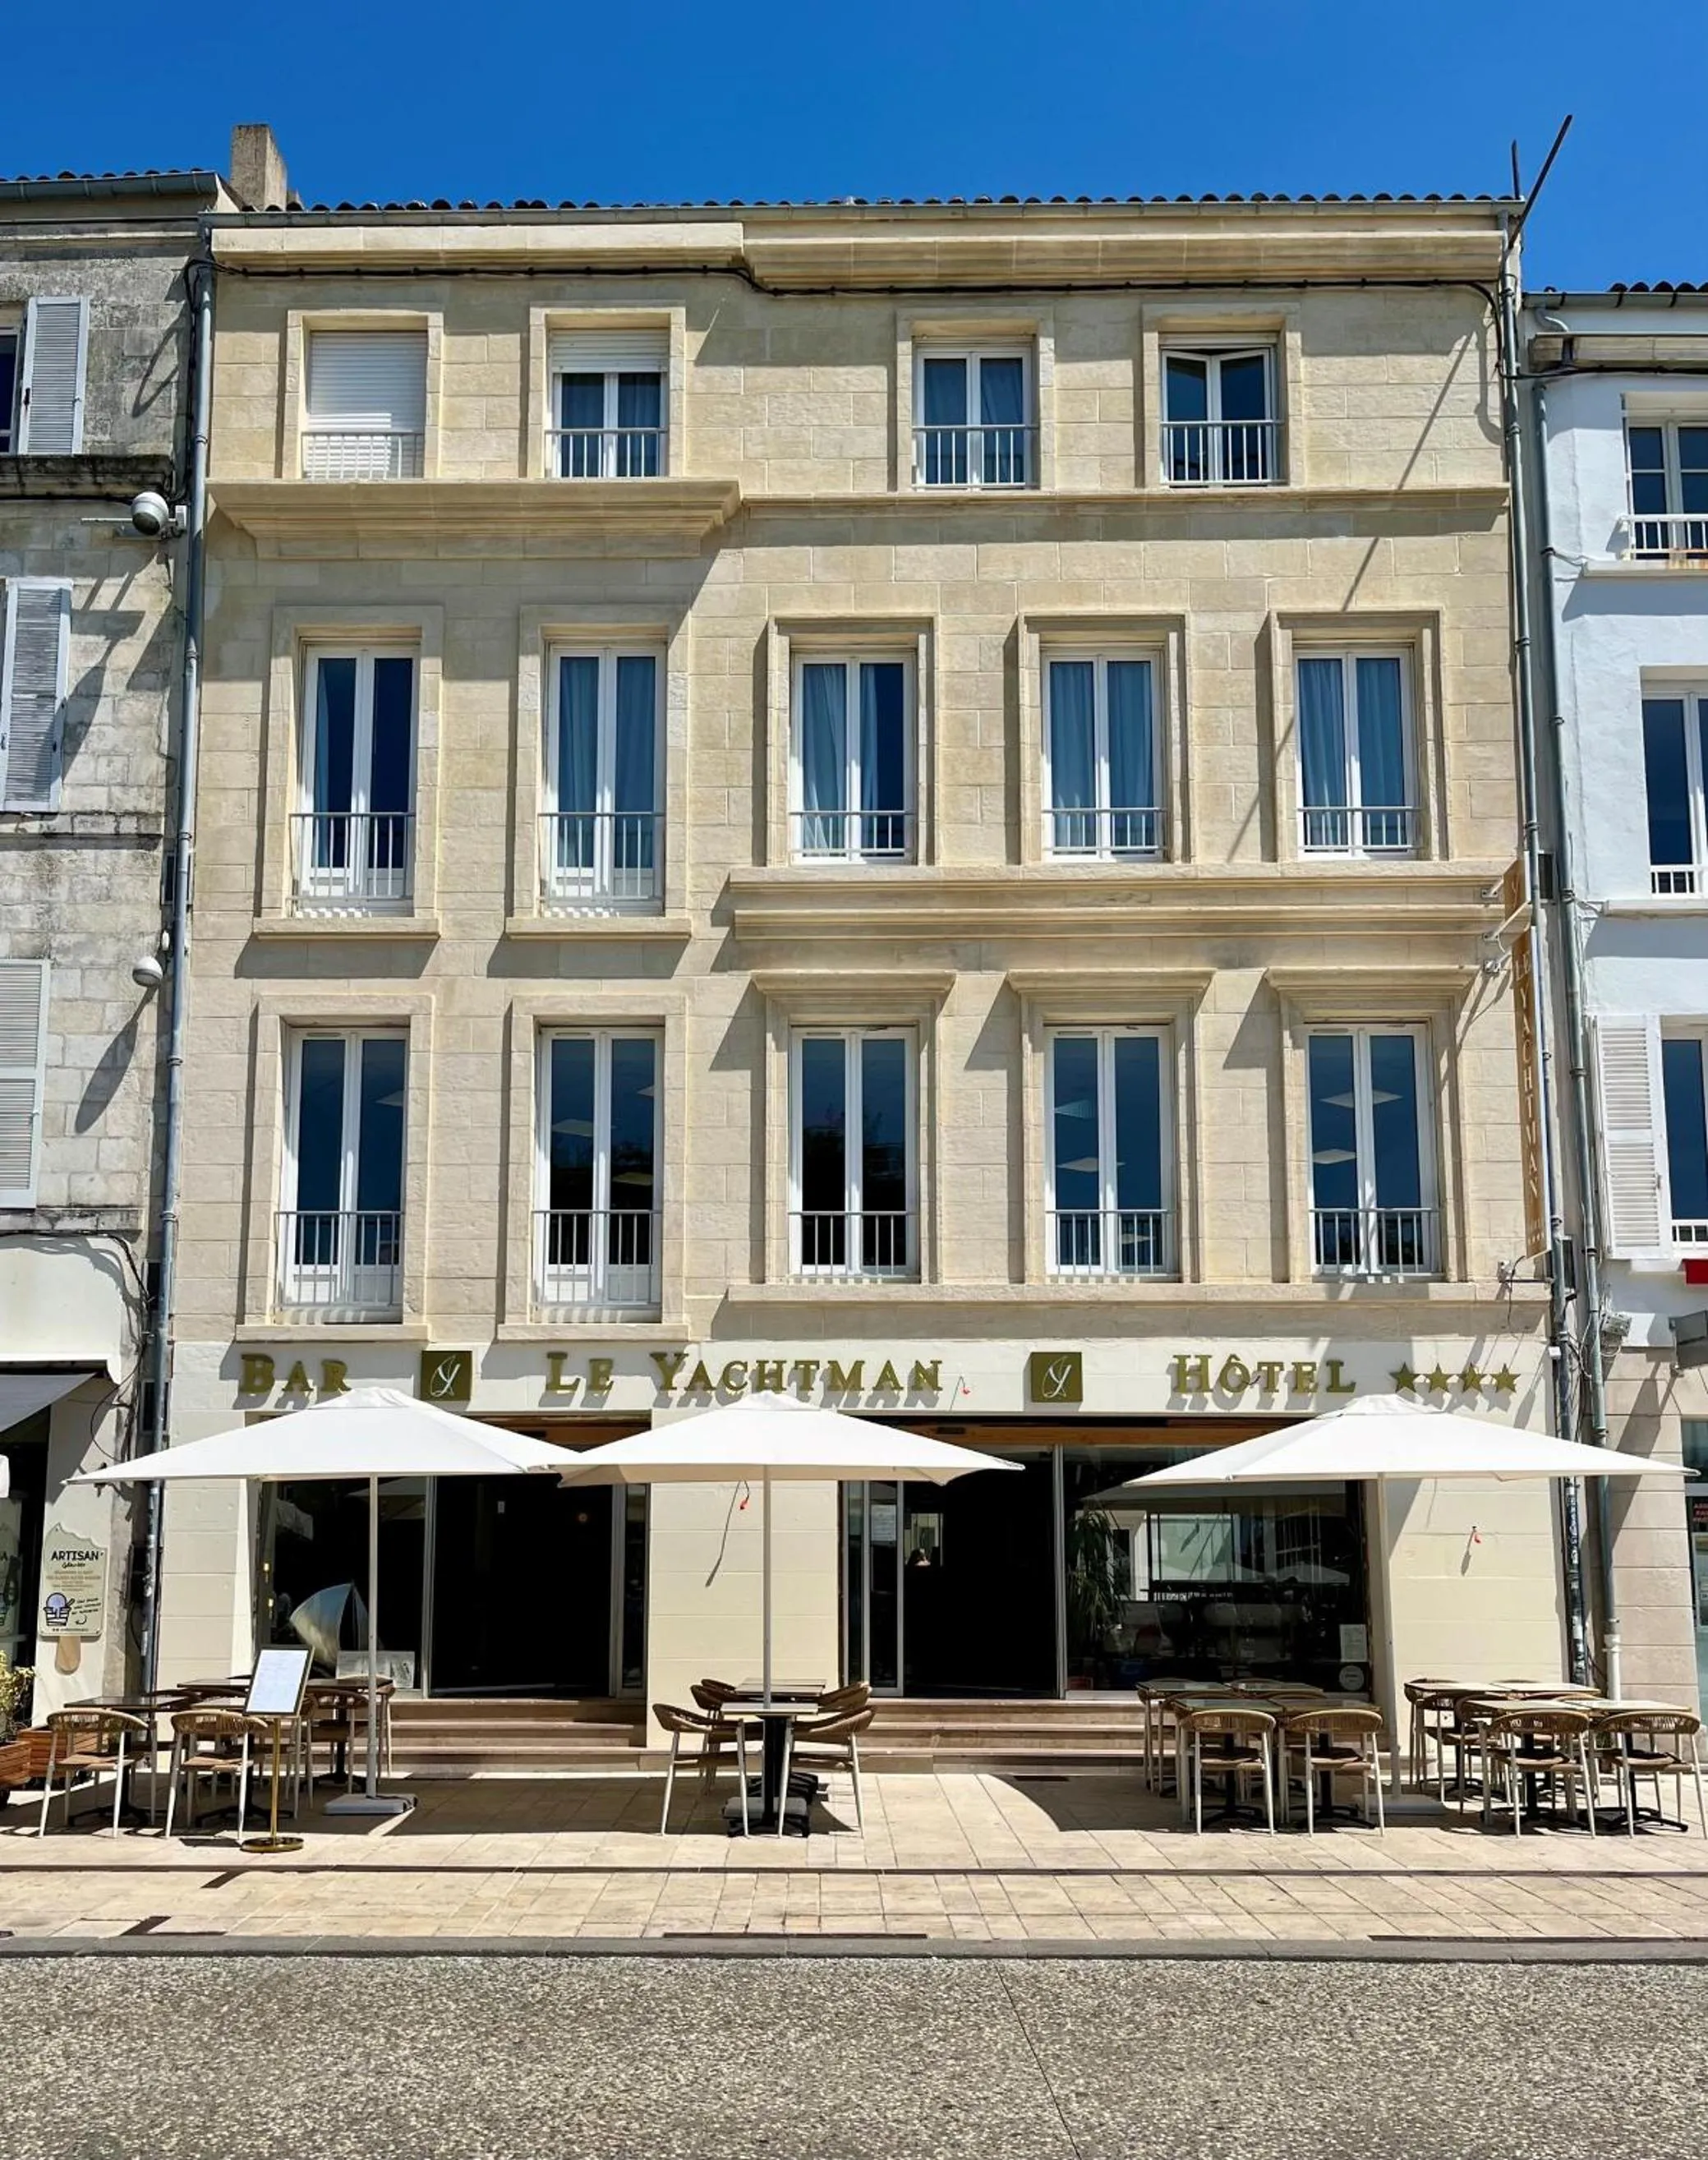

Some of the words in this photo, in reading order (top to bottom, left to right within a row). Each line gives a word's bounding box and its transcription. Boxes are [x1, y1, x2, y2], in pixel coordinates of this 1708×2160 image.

[1520, 980, 1538, 1202] YACHTMAN
[240, 1353, 352, 1393] BAR
[546, 1352, 614, 1391] LE
[650, 1352, 943, 1392] YACHTMAN
[1172, 1354, 1356, 1393] HÔTEL
[51, 1550, 99, 1561] ARTISAN
